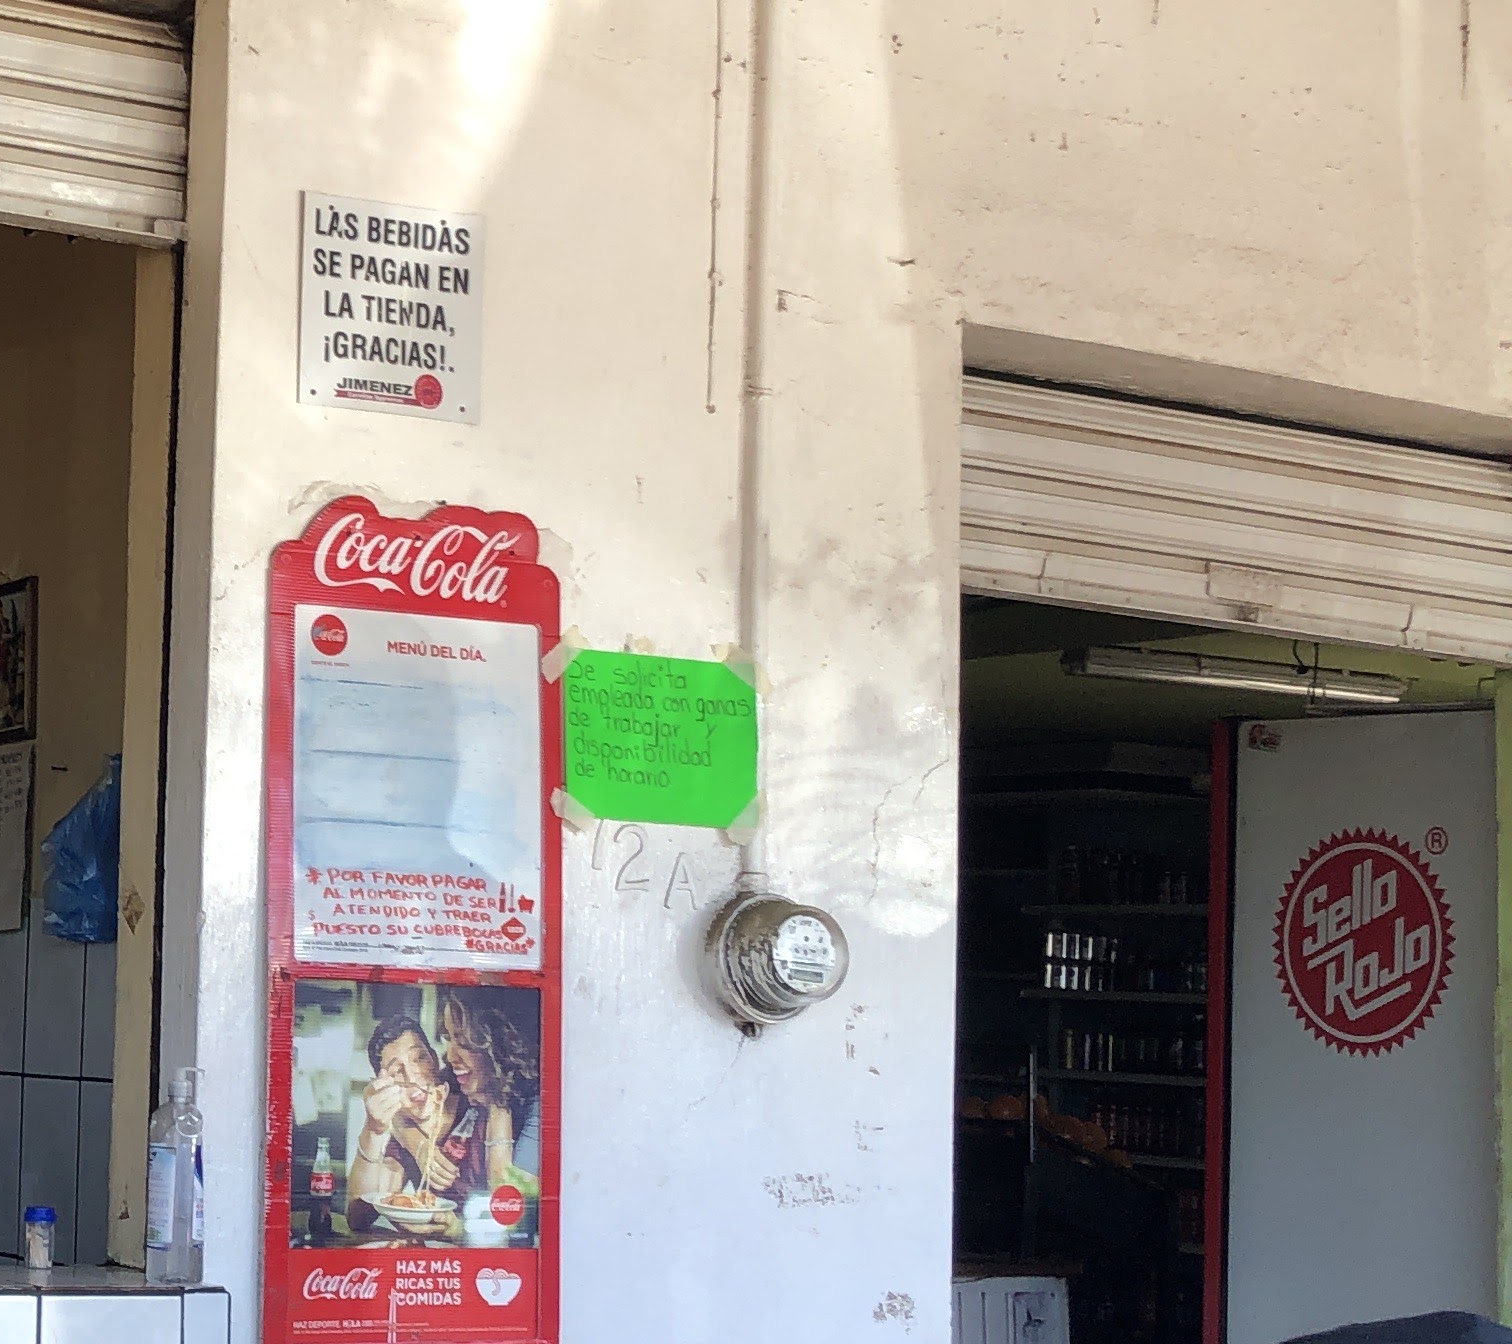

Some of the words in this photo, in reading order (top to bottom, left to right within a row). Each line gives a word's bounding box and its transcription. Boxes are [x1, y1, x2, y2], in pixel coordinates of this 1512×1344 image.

[315, 208, 358, 240] LAS
[367, 216, 470, 255] BEBIDAS
[313, 248, 342, 277] SE
[350, 254, 429, 290] PAGAN
[438, 266, 469, 294] EN
[324, 290, 354, 318] LA
[361, 295, 456, 336] TIENDA,
[336, 377, 413, 396] JIMENEZ
[313, 513, 521, 605] Coca-Cola
[430, 645, 457, 660] DEL
[613, 660, 687, 689] solicita
[662, 695, 692, 713] con
[696, 697, 753, 722] ganas
[569, 708, 590, 728] de
[603, 713, 681, 748] trabajar
[573, 731, 712, 767] disponibilidad
[574, 759, 595, 777] de
[327, 868, 365, 884] POR
[371, 871, 429, 888] FAVOR
[431, 874, 487, 893] PAGAR
[323, 886, 344, 899] AL
[350, 887, 437, 903] MOMENTO
[443, 893, 463, 906] DE
[469, 896, 497, 910] SER
[1303, 859, 1397, 957] Sello
[332, 903, 421, 918] ATENDIDO
[427, 908, 437, 920] Y
[442, 909, 492, 924] TRAER
[312, 922, 381, 937] PUESTO
[386, 924, 409, 936] SU
[396, 1260, 426, 1274] HAZ
[430, 1257, 462, 1274] MÁS
[303, 1267, 383, 1300] Coca-Cola
[396, 1277, 434, 1290] RICAS
[438, 1277, 461, 1290] TUS
[395, 1293, 462, 1306] COMIDAS
